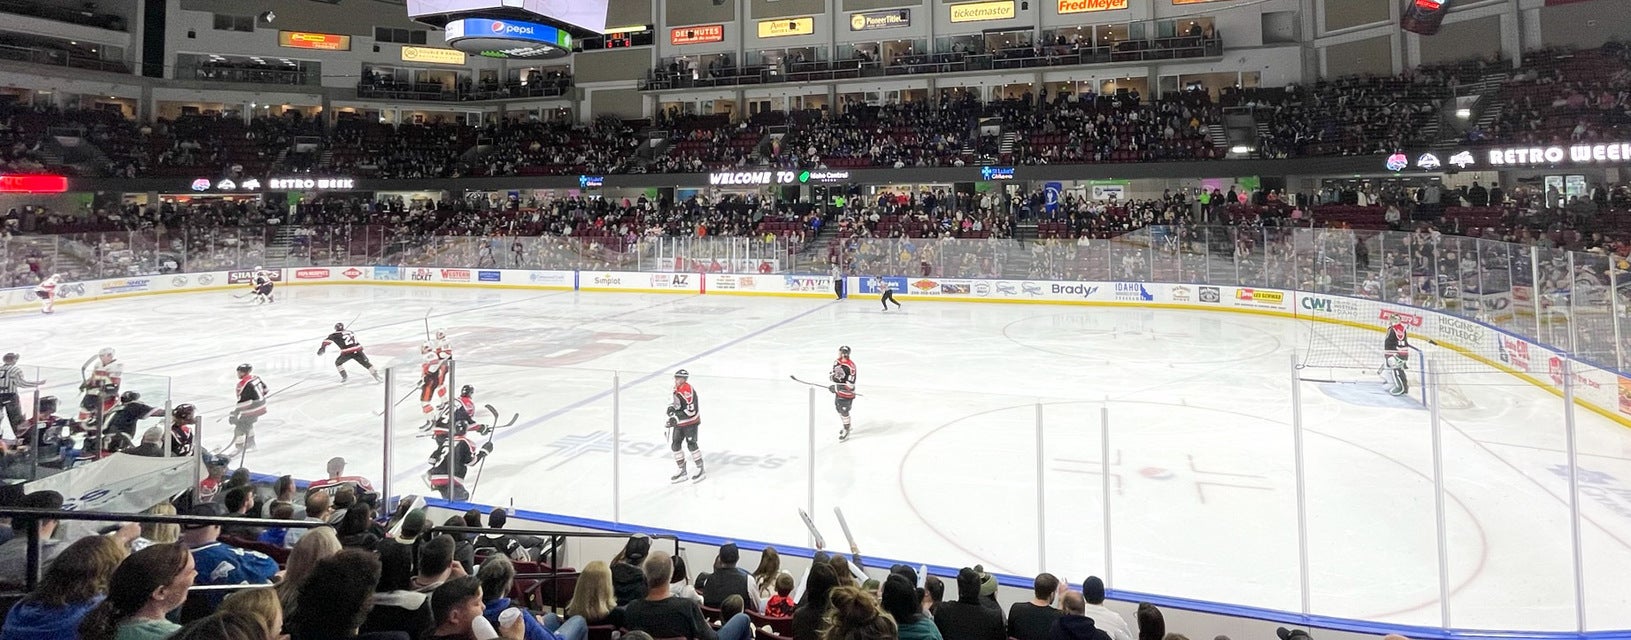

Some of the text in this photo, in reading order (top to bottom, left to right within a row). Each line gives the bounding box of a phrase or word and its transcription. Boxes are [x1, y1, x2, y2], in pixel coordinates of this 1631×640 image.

[953, 6, 1011, 18] ticketmaster
[506, 25, 534, 35] pepsi
[1489, 147, 1564, 165] RETRO
[270, 179, 354, 189] RETRO WEEK
[710, 171, 795, 185] WELCOME TO
[441, 269, 471, 280] WESTERN
[594, 276, 621, 286] Simplot
[1051, 283, 1092, 298] Brady
[1115, 283, 1139, 292] IDAHO
[1302, 296, 1332, 312] CWI
[1438, 315, 1473, 332] HIGGINS
